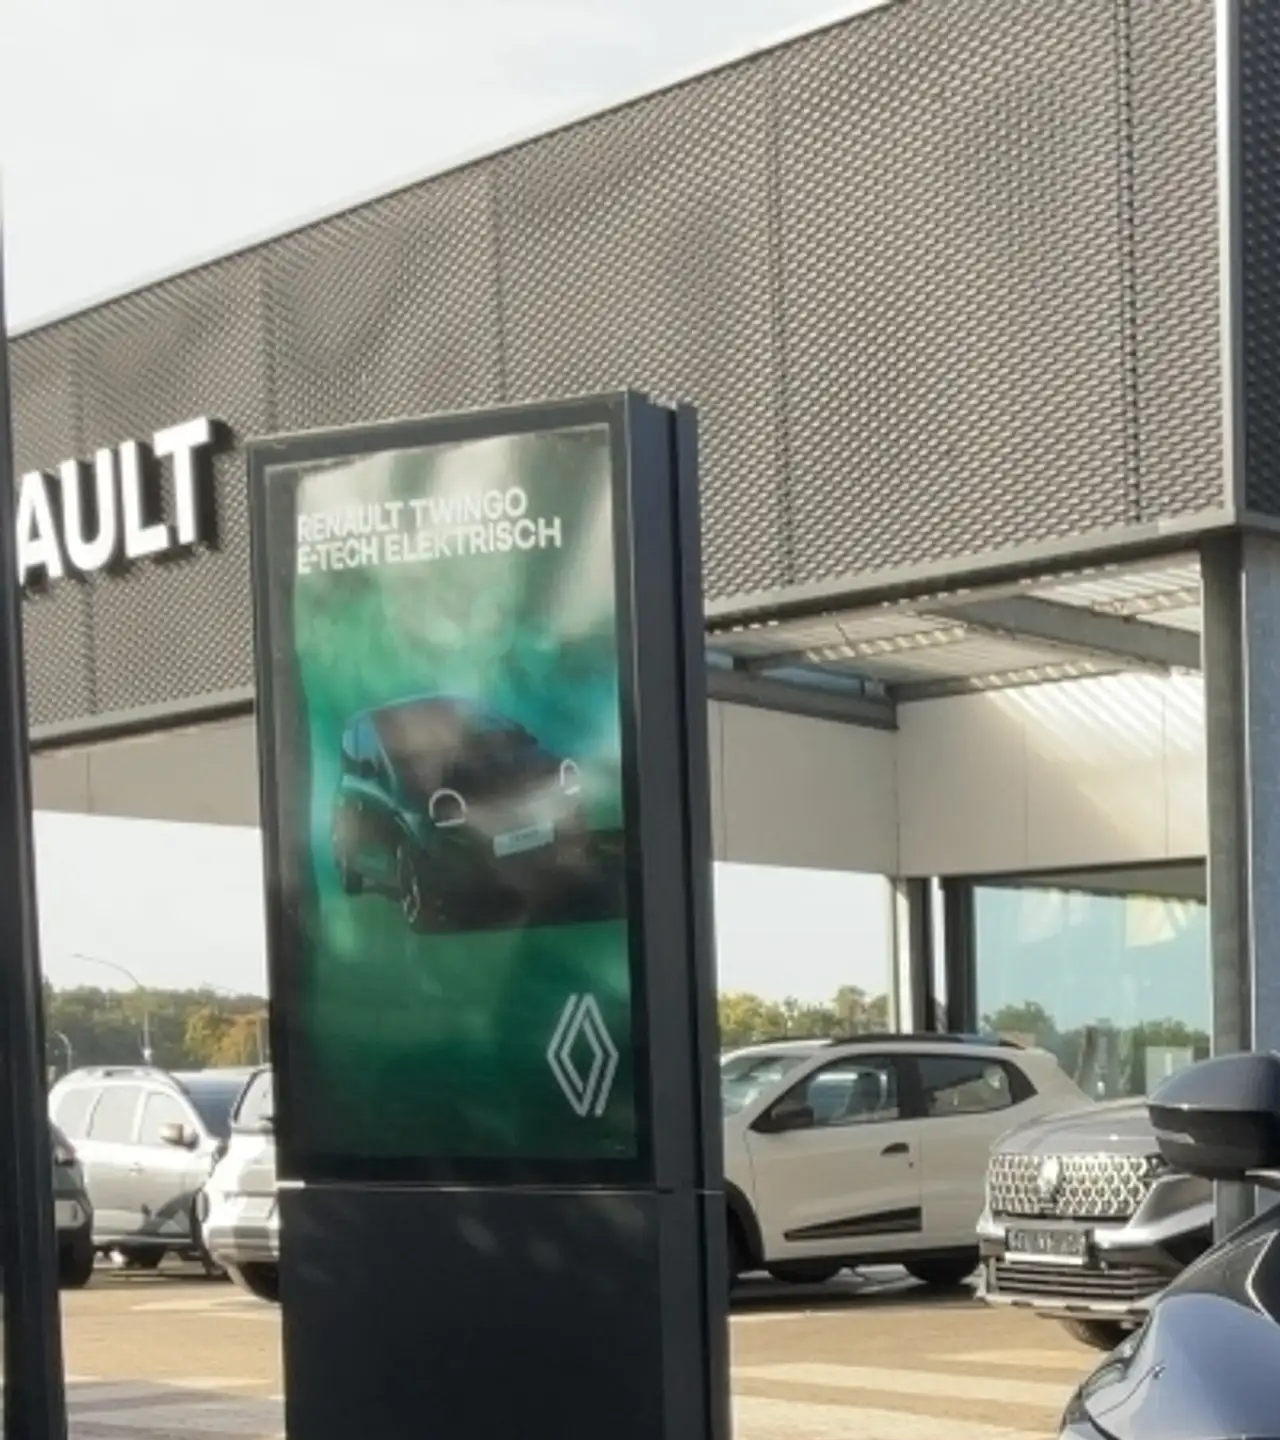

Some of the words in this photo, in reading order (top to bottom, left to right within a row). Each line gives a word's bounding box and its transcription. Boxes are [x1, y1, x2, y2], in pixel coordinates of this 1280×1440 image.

[297, 502, 404, 543] RENAULT
[410, 486, 528, 528] TWINGO
[297, 537, 378, 574] E-TECH
[386, 517, 562, 564] ELEKTRISCH
